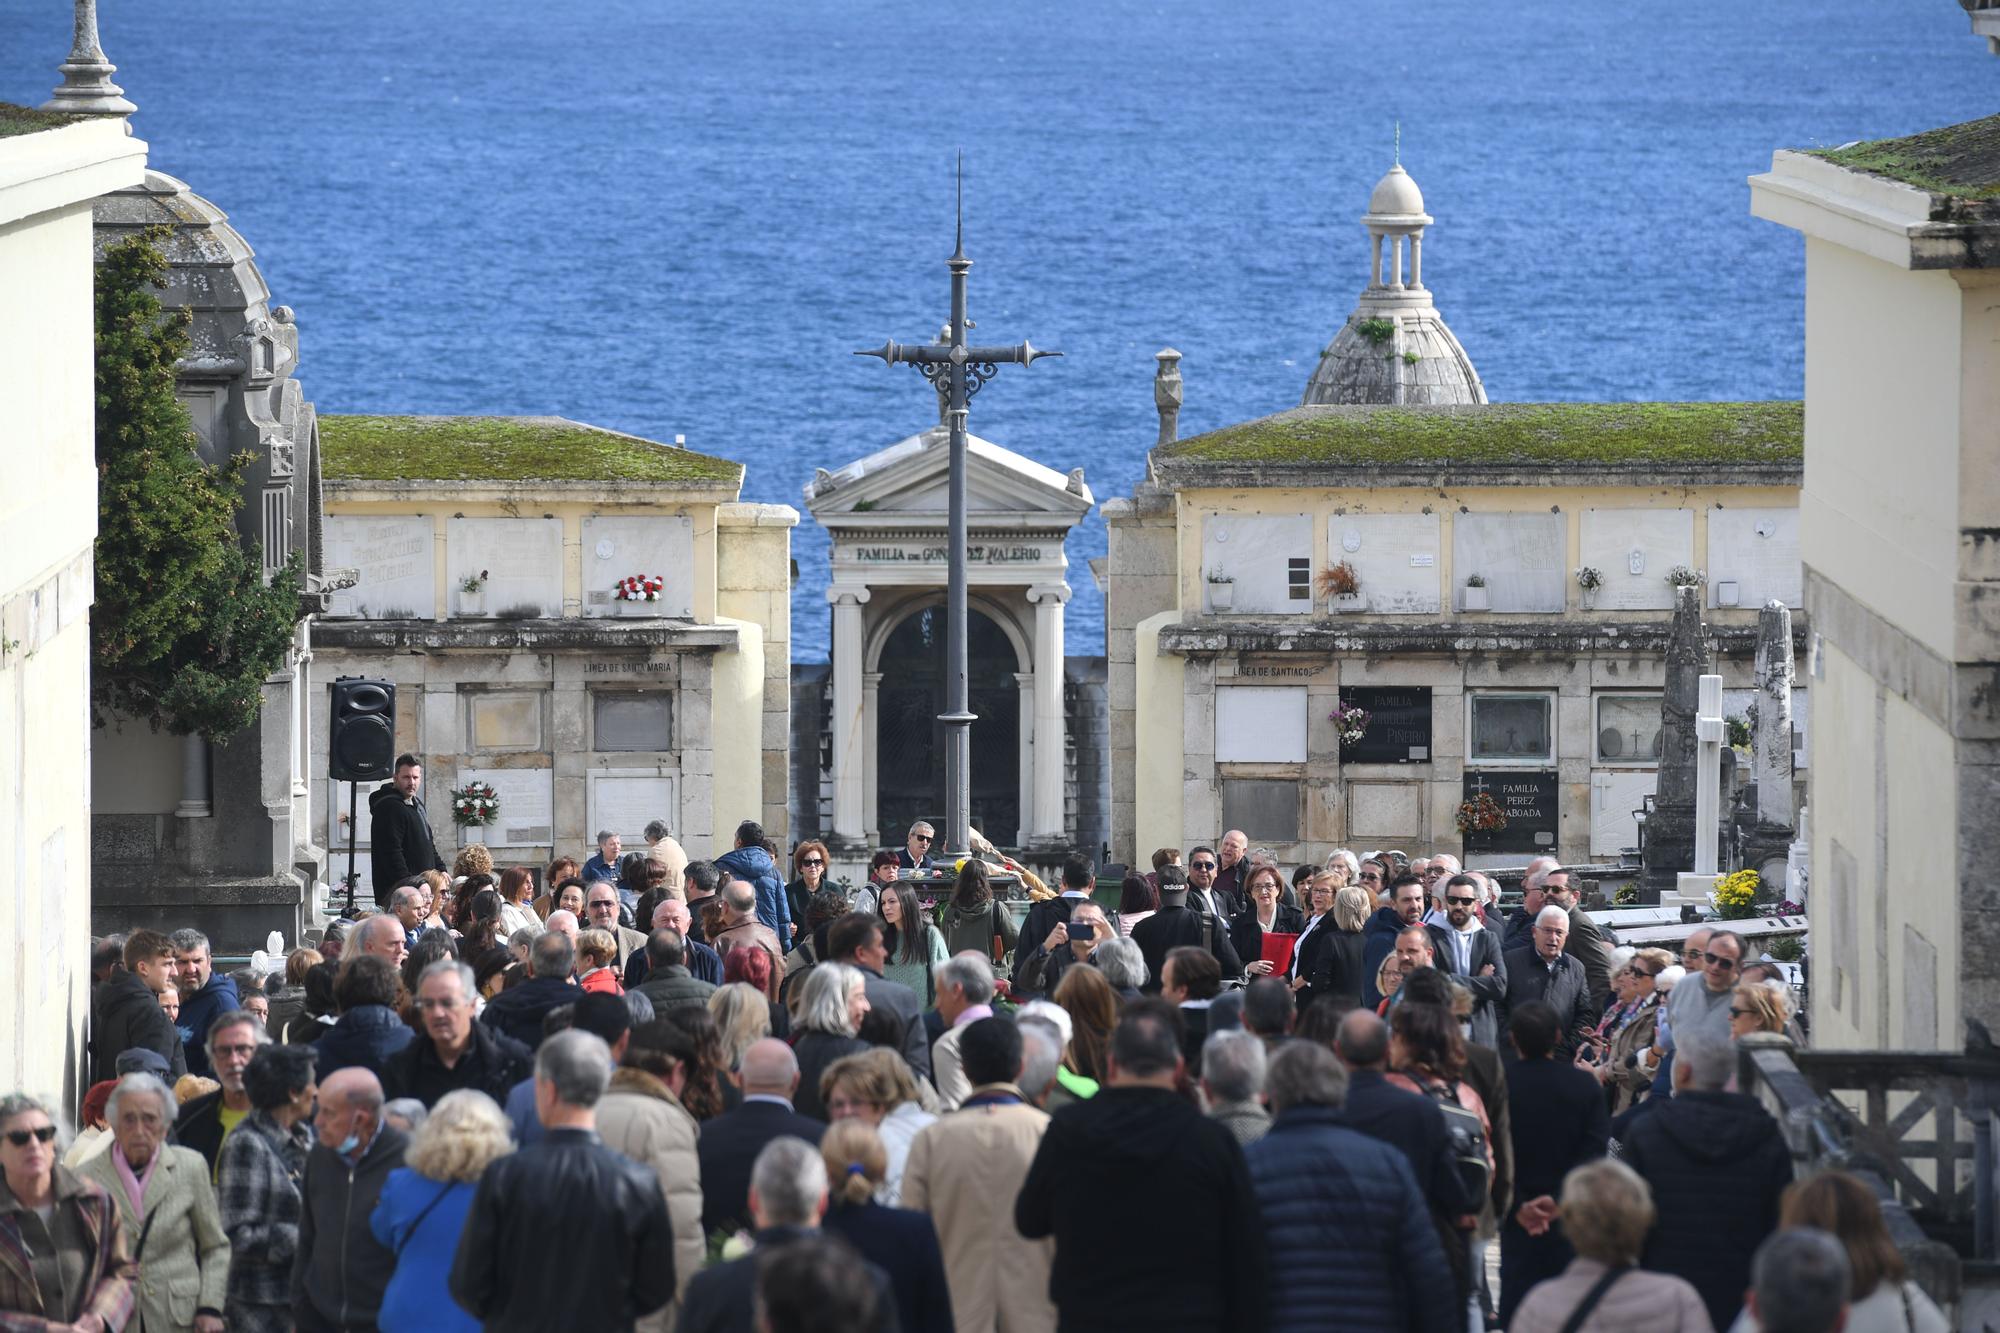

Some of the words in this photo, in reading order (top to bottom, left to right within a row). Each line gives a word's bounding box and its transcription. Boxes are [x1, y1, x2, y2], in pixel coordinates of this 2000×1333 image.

[857, 547, 904, 560] FAMILIA
[922, 547, 984, 560] GONEZ
[609, 663, 620, 672] DE
[623, 663, 645, 672] SANTA
[647, 662, 671, 672] MARIA
[1258, 667, 1268, 676] DE
[1374, 695, 1413, 707] FAMILIA
[1502, 784, 1539, 793] FAMILIA
[1507, 796, 1535, 805] PEREZ
[1505, 808, 1541, 817] ABOADA
